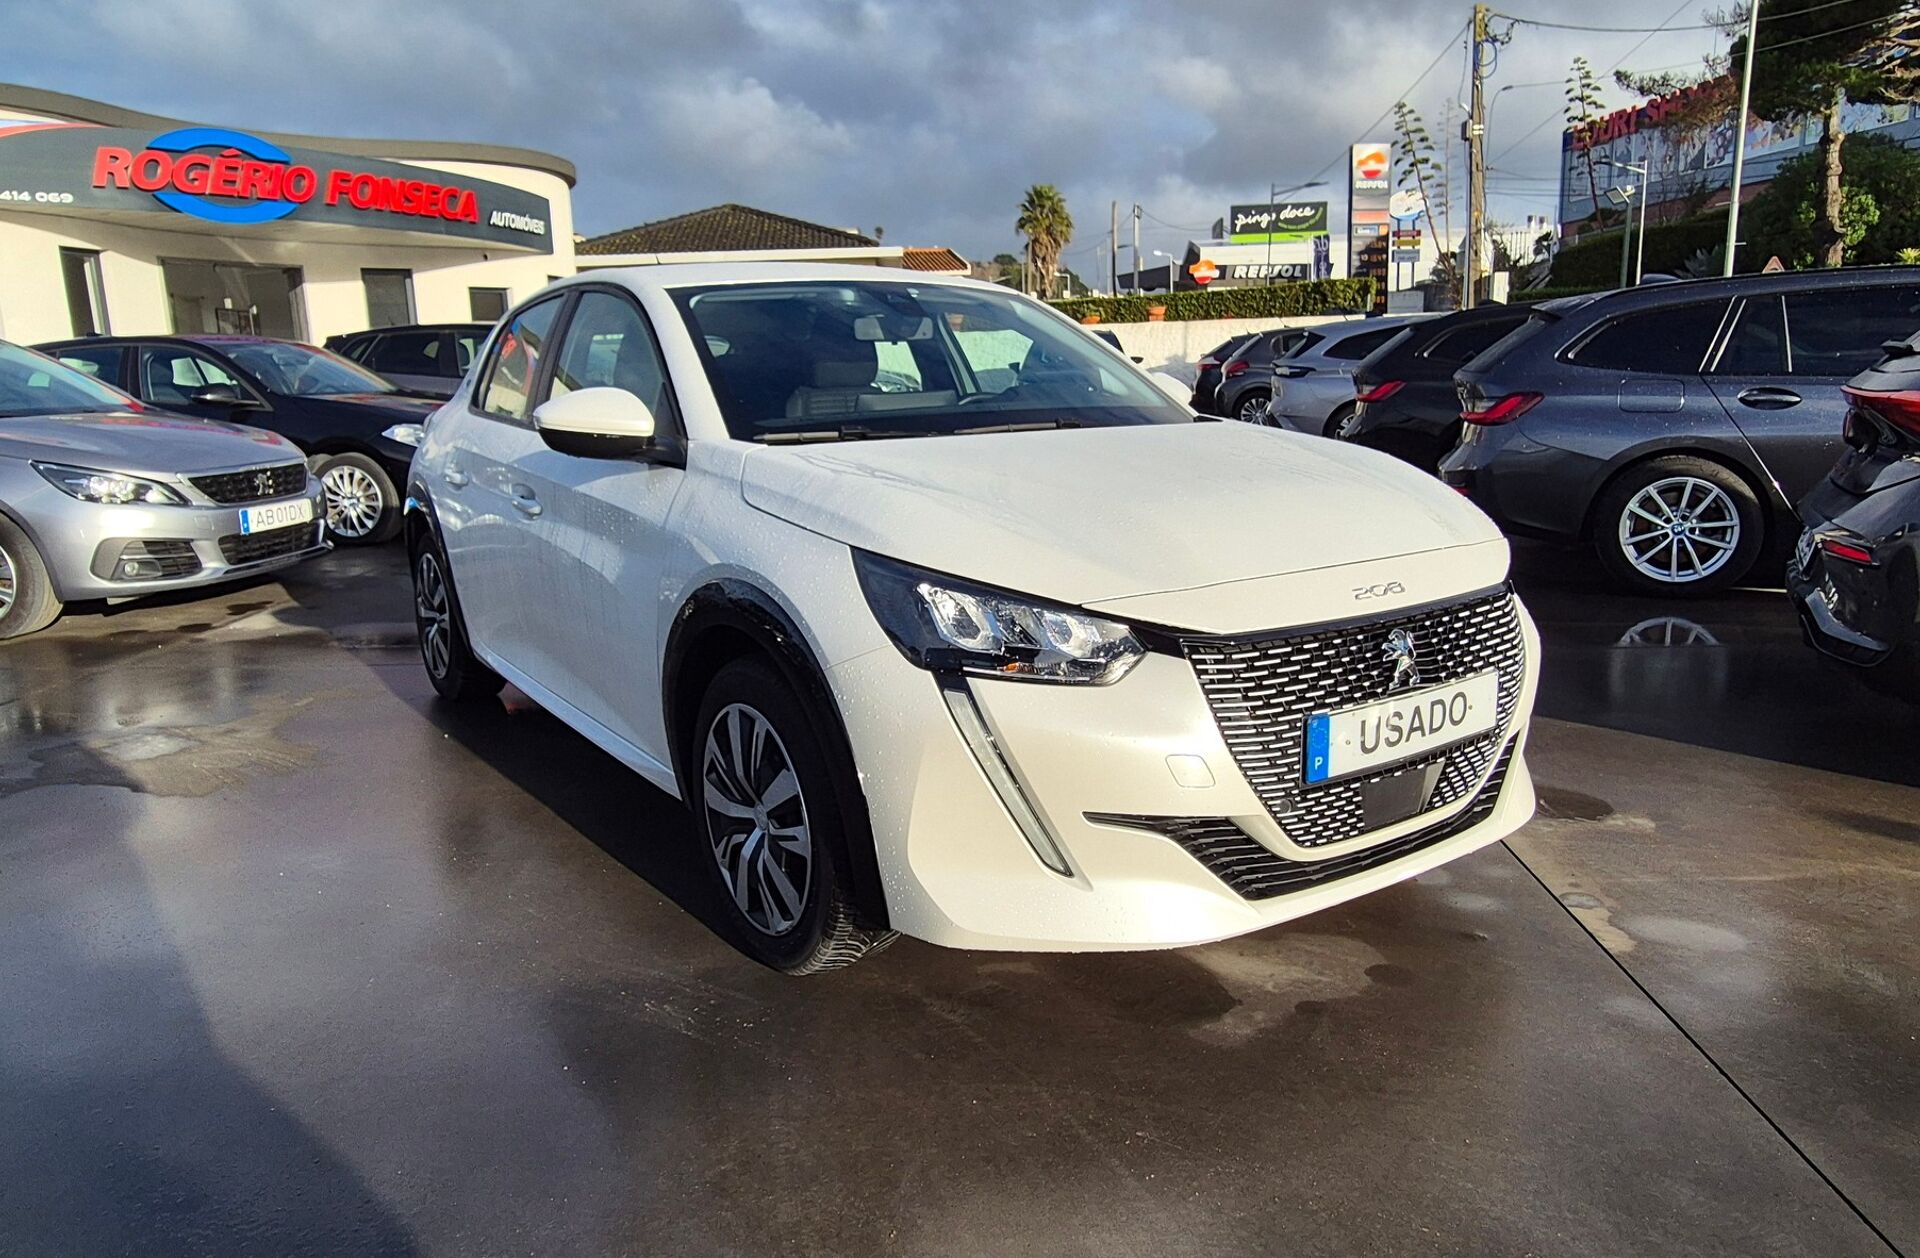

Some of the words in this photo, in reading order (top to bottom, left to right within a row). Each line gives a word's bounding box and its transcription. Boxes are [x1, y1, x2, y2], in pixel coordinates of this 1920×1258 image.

[92, 146, 318, 203] ROGÉRIO
[325, 169, 479, 224] FONSECA
[0, 190, 31, 201] 414
[35, 192, 73, 203] 069
[1280, 205, 1315, 220] doce
[490, 210, 545, 235] AUTOMÓVEIS
[1233, 265, 1302, 278] REPSOL
[1352, 581, 1406, 600] 208
[1360, 691, 1467, 755] USADO
